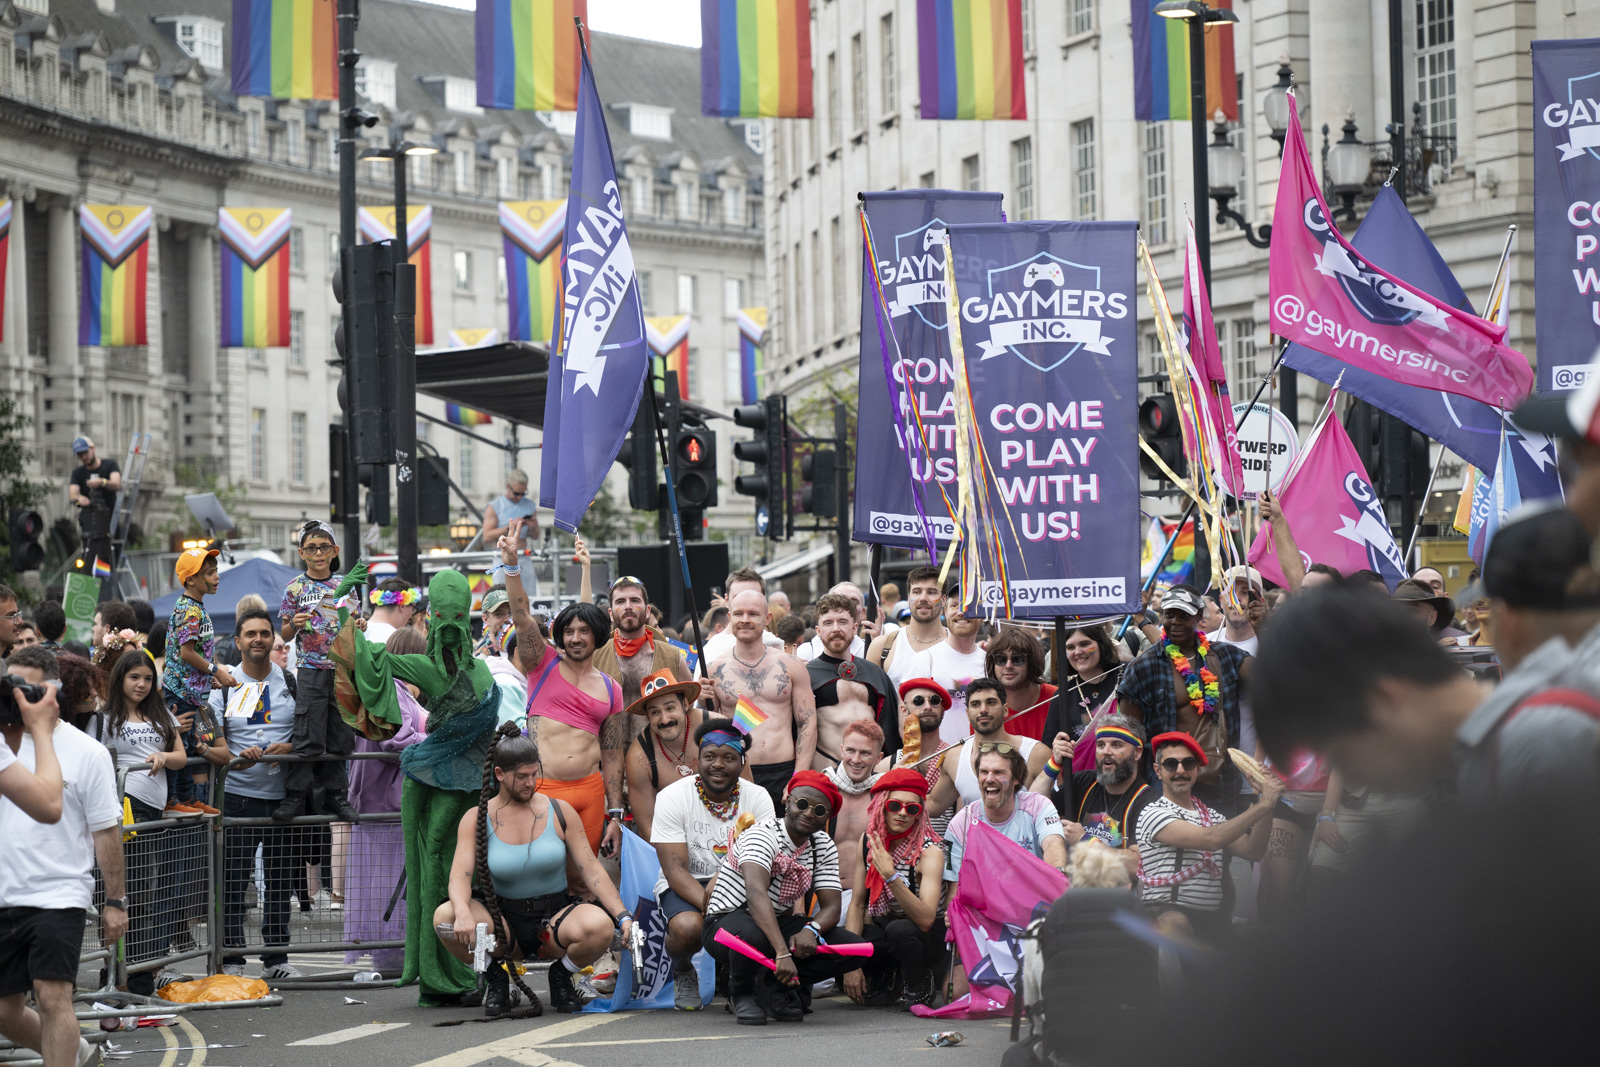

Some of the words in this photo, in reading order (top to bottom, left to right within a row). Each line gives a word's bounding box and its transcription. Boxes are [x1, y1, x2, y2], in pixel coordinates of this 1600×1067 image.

[961, 289, 1128, 324] GAYMERS
[1022, 321, 1072, 341] iNC.
[1273, 293, 1471, 384] @gaymersinc
[990, 400, 1104, 434] COME
[1000, 437, 1098, 470] PLAY
[1239, 440, 1287, 456] TWERP
[997, 473, 1101, 505] WITH
[1021, 511, 1082, 542] US!
[983, 580, 1123, 605] @gaymersinc
